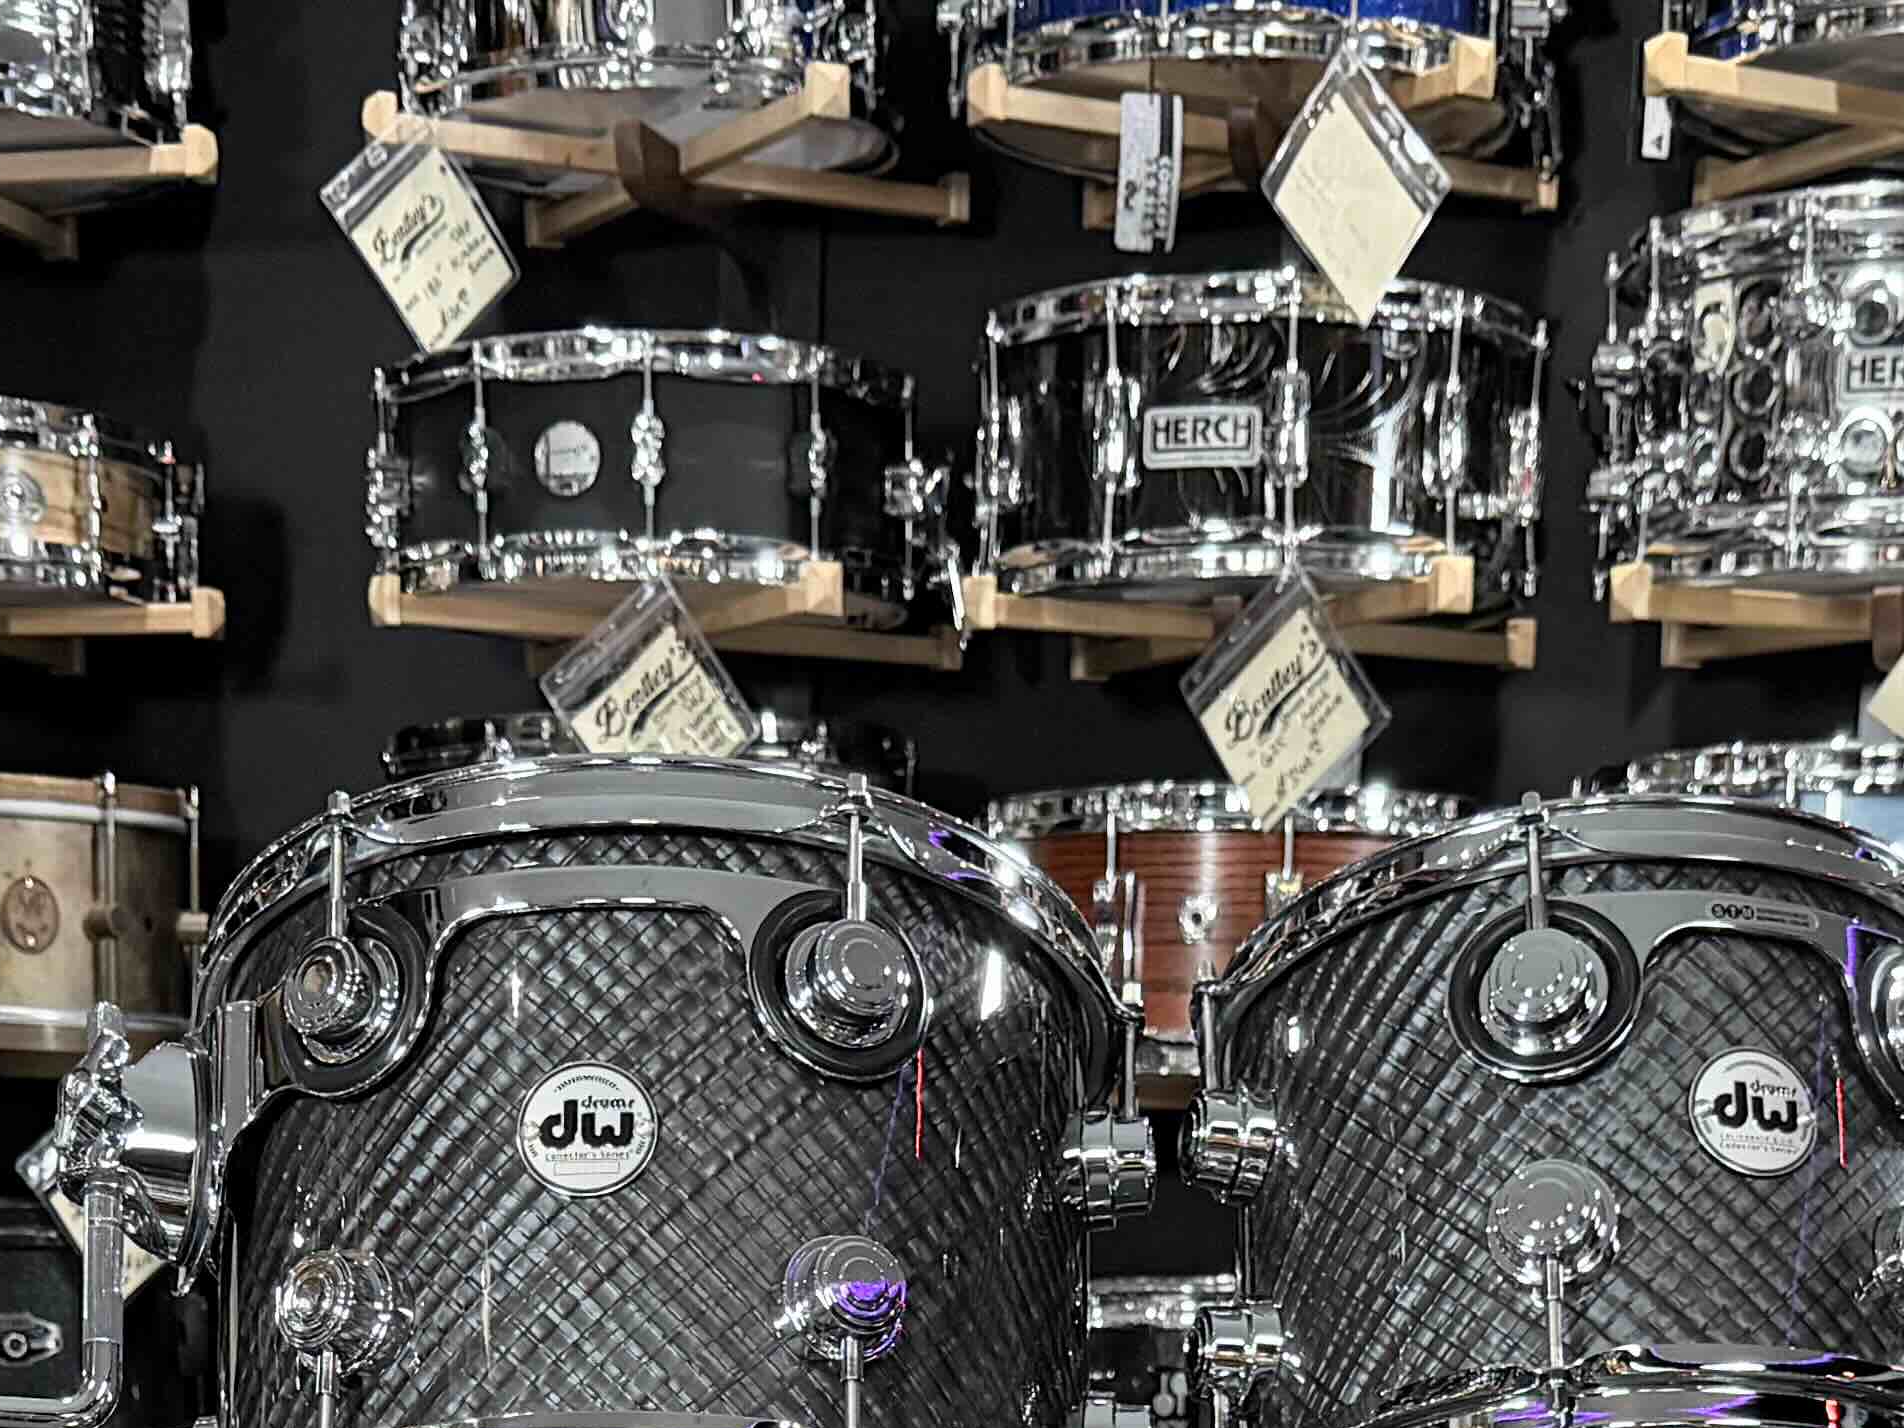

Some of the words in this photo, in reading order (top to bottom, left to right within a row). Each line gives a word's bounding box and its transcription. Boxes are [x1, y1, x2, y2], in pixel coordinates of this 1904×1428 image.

[1153, 416, 1252, 445] HERCH
[596, 640, 688, 747] Bentley's
[1224, 638, 1318, 750] Bentley's
[580, 1096, 635, 1109] drums
[1713, 1081, 1798, 1133] dw
[1749, 1080, 1797, 1098] drums
[539, 1100, 635, 1150] dw
